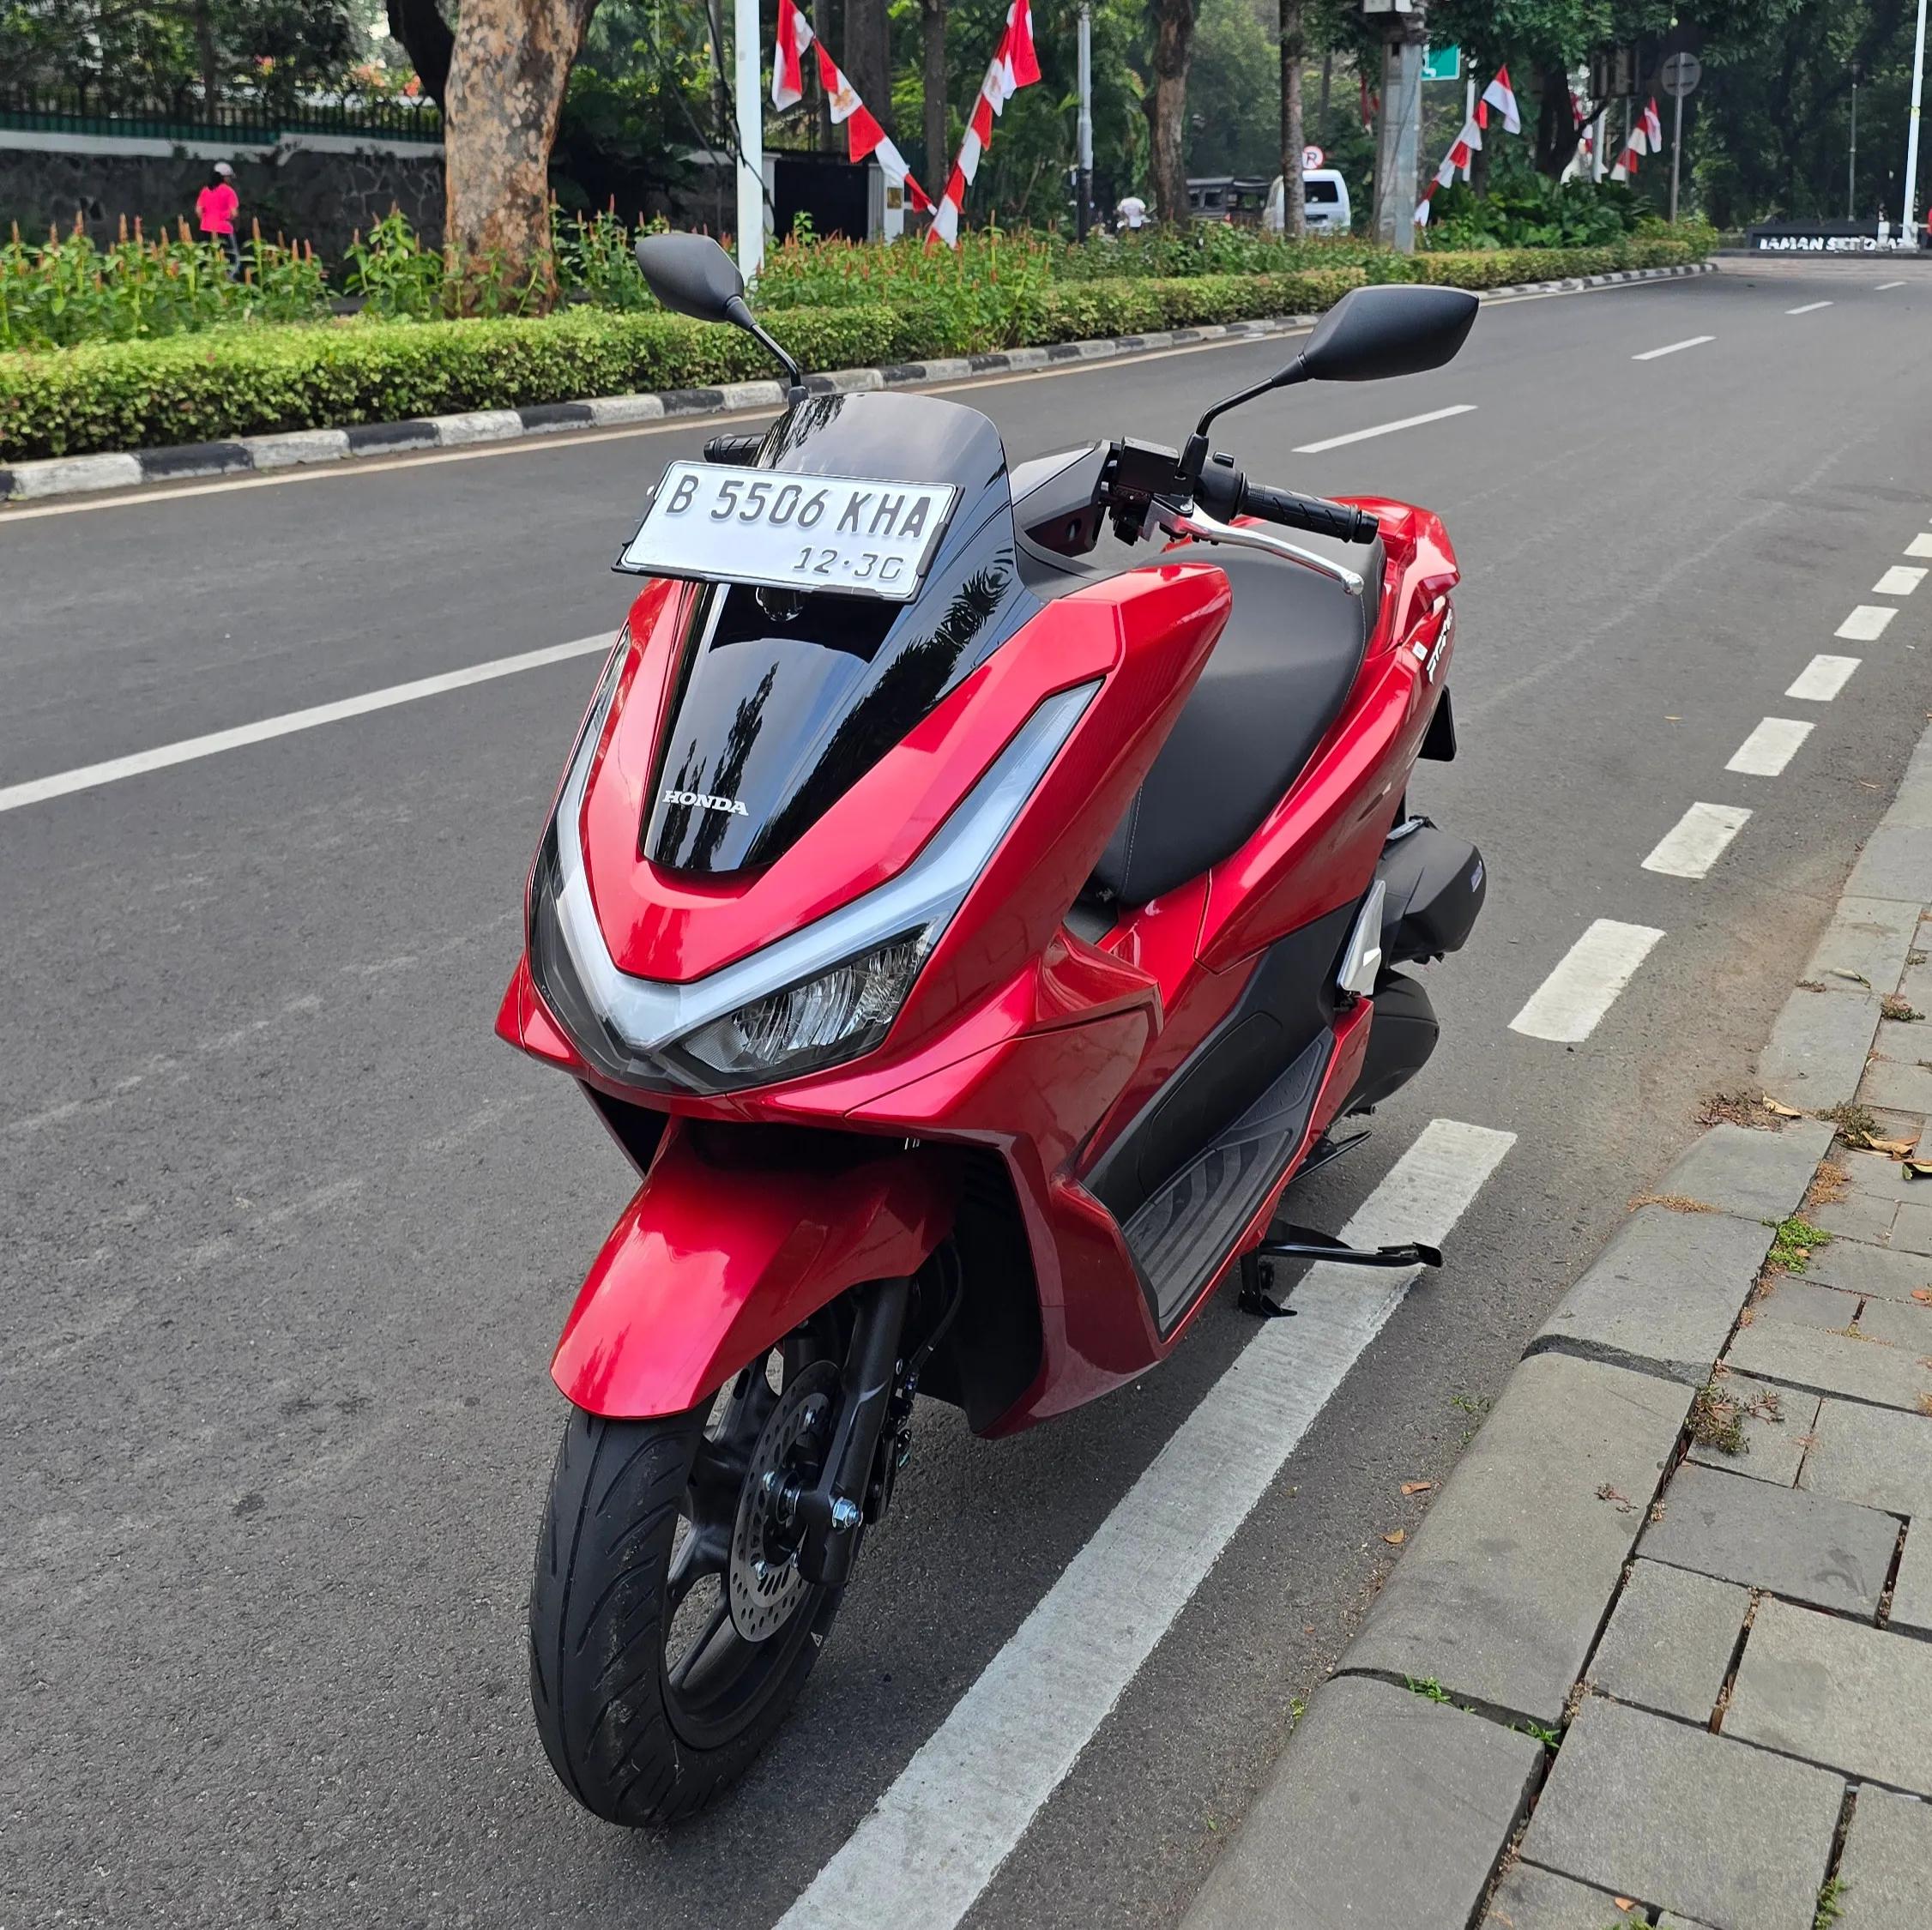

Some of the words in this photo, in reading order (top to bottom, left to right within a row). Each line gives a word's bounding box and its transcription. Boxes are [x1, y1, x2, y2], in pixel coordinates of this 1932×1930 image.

[666, 474, 698, 514] B
[710, 479, 830, 528] 5506
[836, 491, 932, 538] KHA
[662, 790, 750, 816] HONDA
